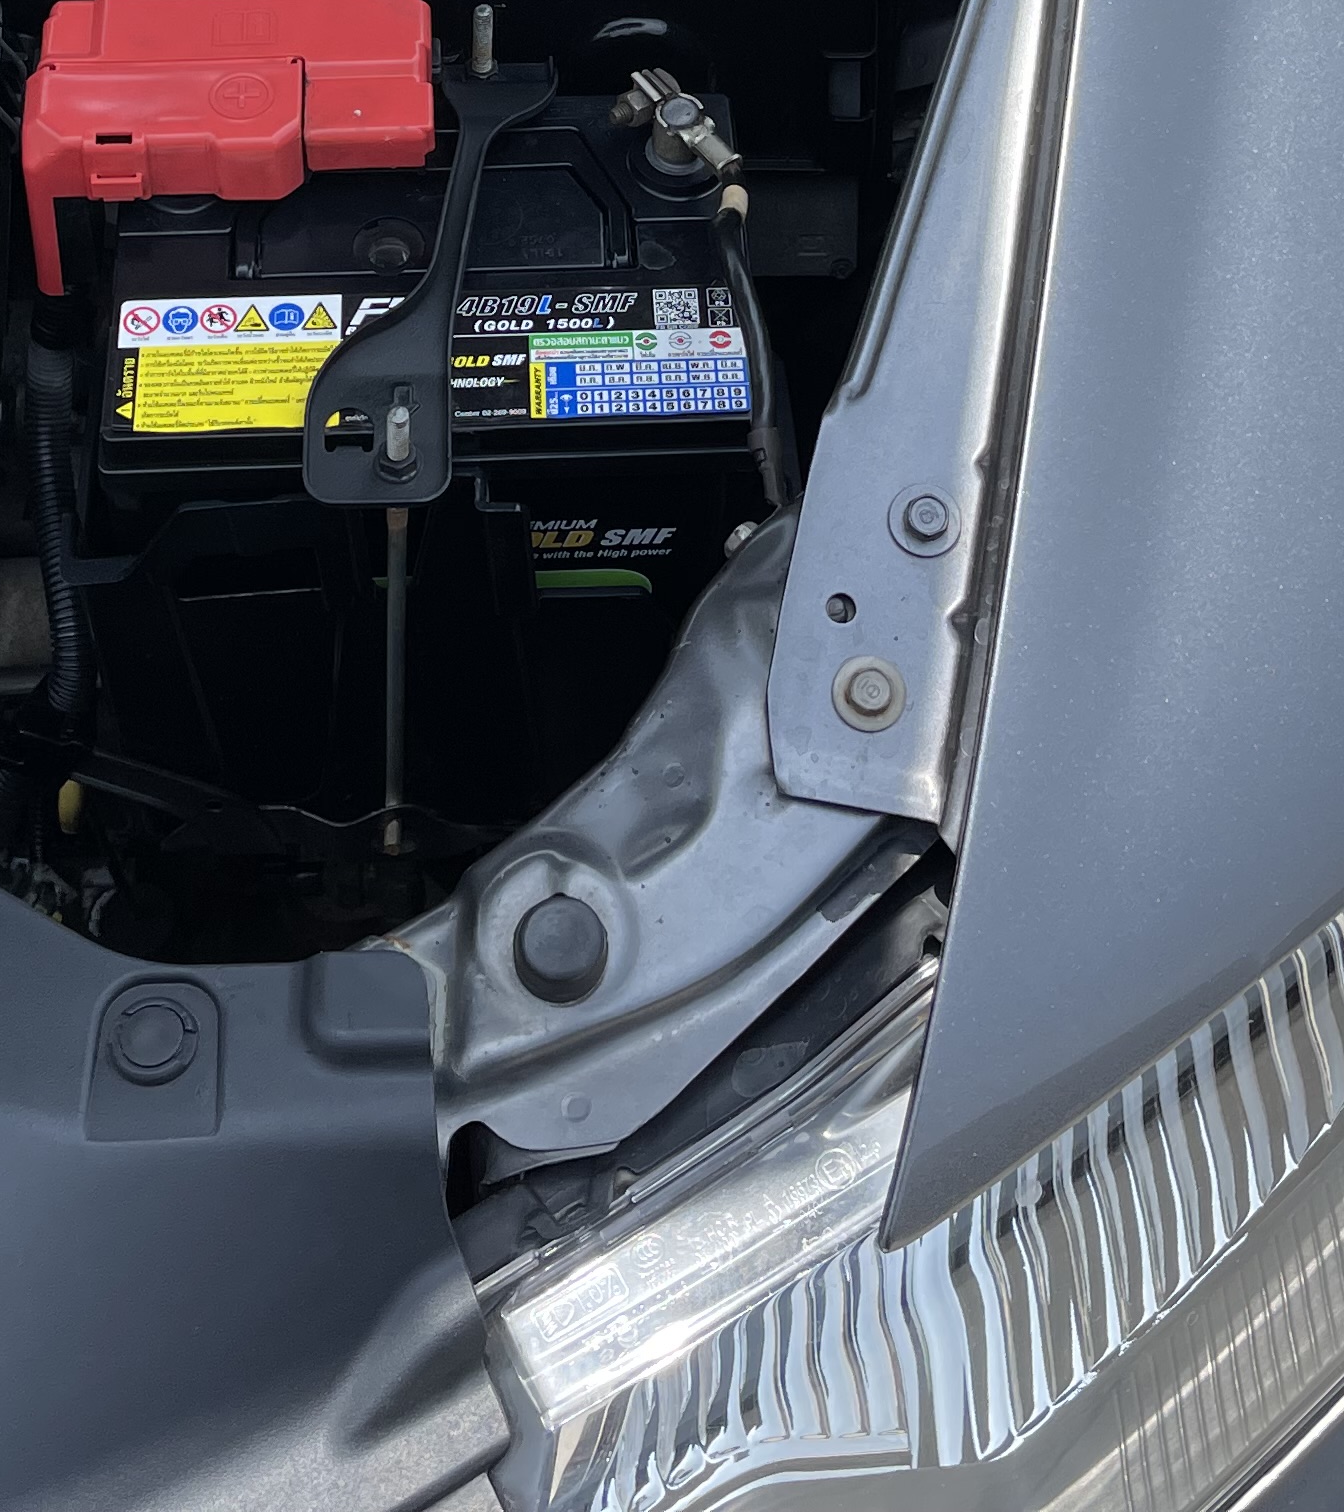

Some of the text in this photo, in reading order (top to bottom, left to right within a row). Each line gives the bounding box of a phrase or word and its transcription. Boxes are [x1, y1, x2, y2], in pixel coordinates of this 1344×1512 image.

[451, 355, 490, 368] OLD
[492, 353, 526, 367] SMF
[580, 392, 588, 400] 0
[597, 392, 603, 400] 1
[614, 391, 623, 399] 2
[631, 391, 640, 399] 3
[647, 390, 657, 398] 4
[699, 389, 708, 397] 7
[580, 404, 589, 412] 0
[597, 404, 604, 412] 1
[614, 404, 623, 412] 2
[631, 403, 640, 411] 3
[648, 403, 657, 411] 4
[700, 401, 708, 409] 7
[601, 527, 677, 546] SMF
[542, 550, 570, 559] with
[573, 550, 594, 558] the
[597, 549, 628, 559] High
[631, 547, 673, 558] power
